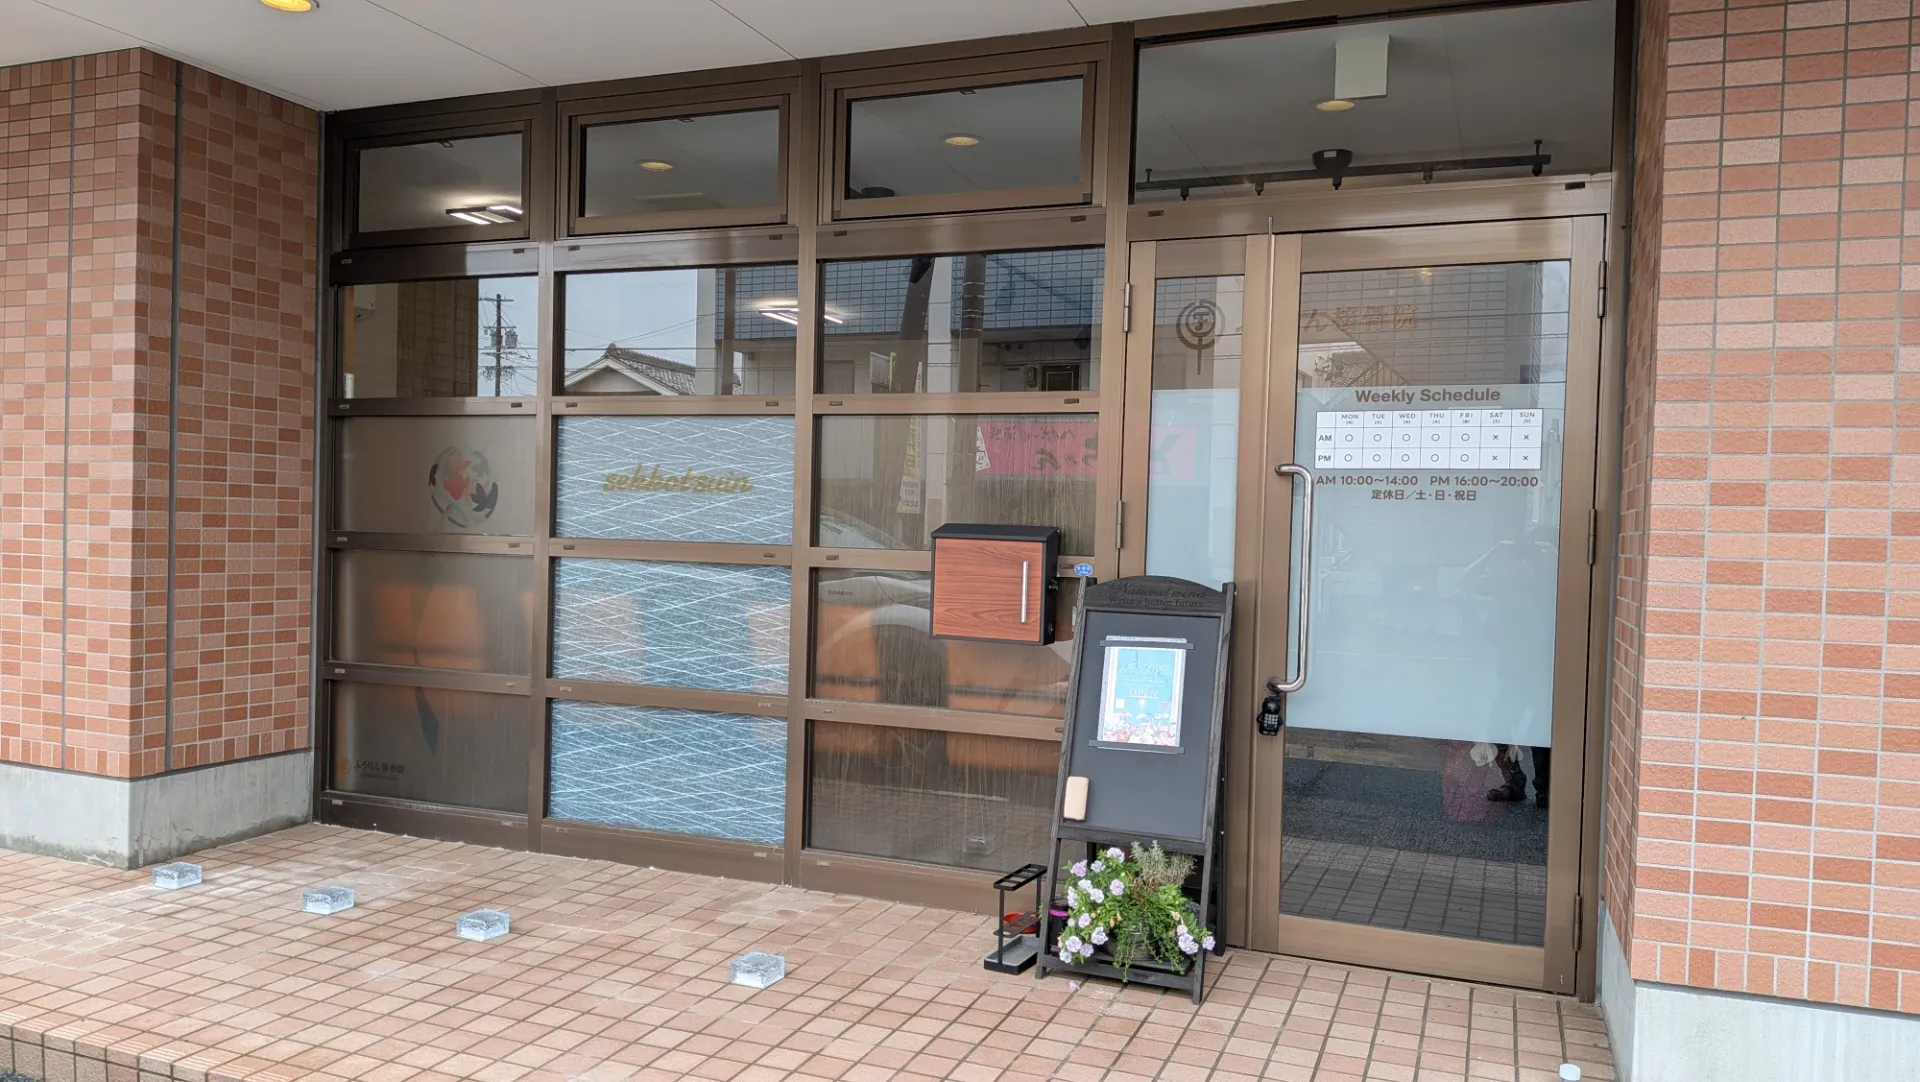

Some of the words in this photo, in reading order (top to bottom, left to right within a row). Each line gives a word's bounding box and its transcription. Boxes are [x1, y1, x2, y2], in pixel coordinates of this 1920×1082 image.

[1355, 389, 1415, 404] Weekly
[1420, 388, 1501, 402] Schedule
[1489, 411, 1504, 419] SAT
[1318, 434, 1333, 442] AM
[1317, 454, 1332, 463] PM
[1316, 475, 1336, 486] AM
[1429, 475, 1450, 486] PM
[1109, 595, 1135, 605] Write
[1173, 598, 1205, 608] future
